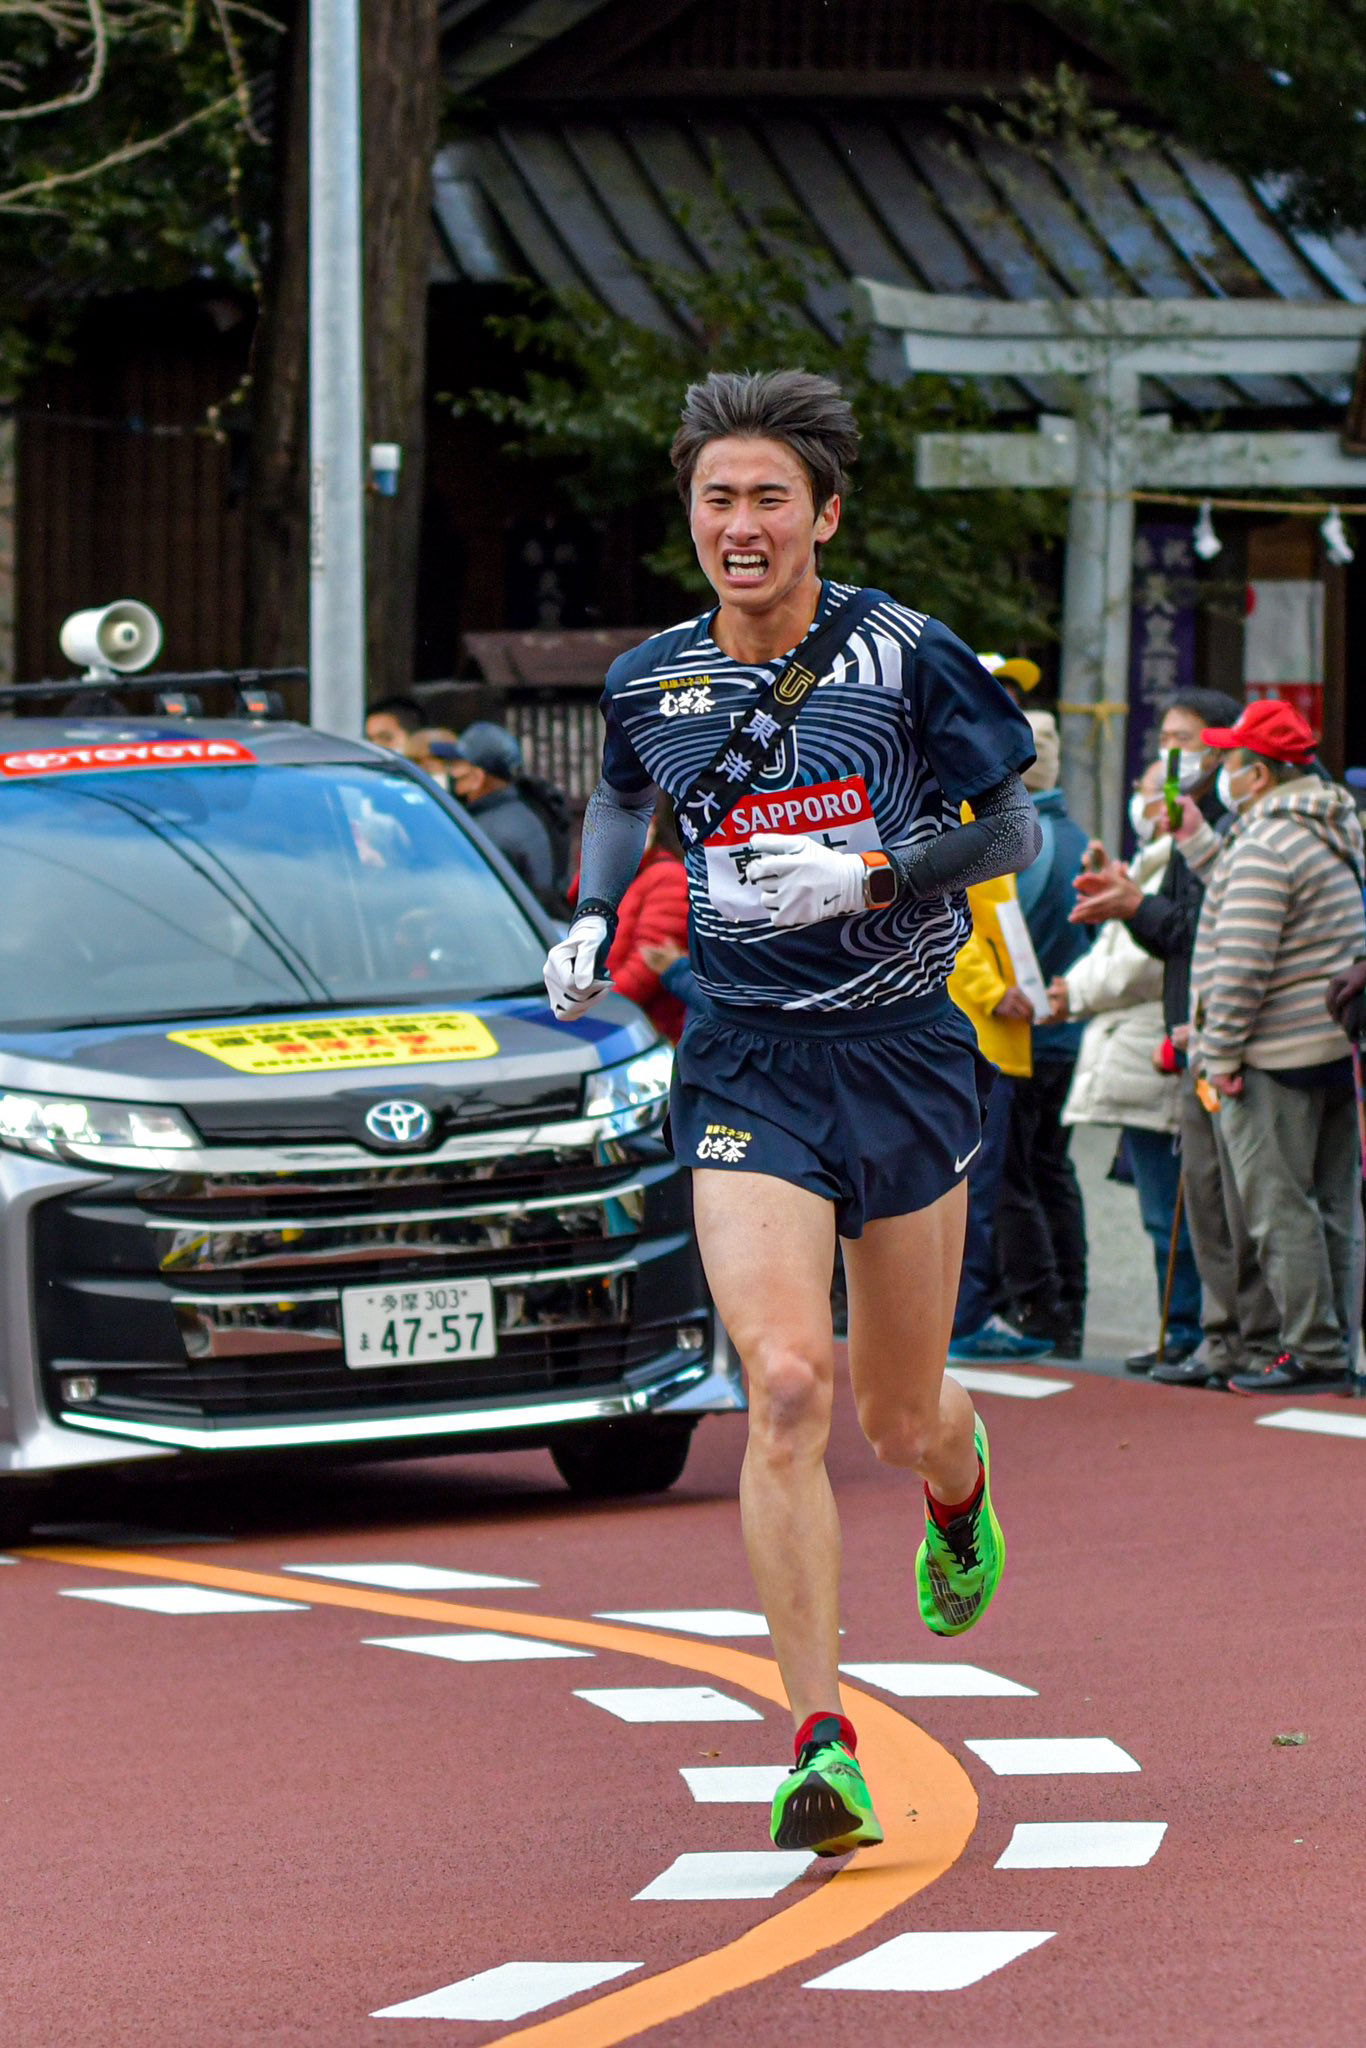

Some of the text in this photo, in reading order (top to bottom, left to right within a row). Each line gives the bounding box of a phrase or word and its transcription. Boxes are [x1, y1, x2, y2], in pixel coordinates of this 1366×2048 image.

[659, 686, 716, 717] むぎ茶
[67, 743, 237, 763] TOYOTA
[731, 789, 862, 835] SAPPORO
[696, 1135, 747, 1163] むぎ茶
[380, 1289, 460, 1313] 多摩 303
[380, 1312, 484, 1358] 47-57
